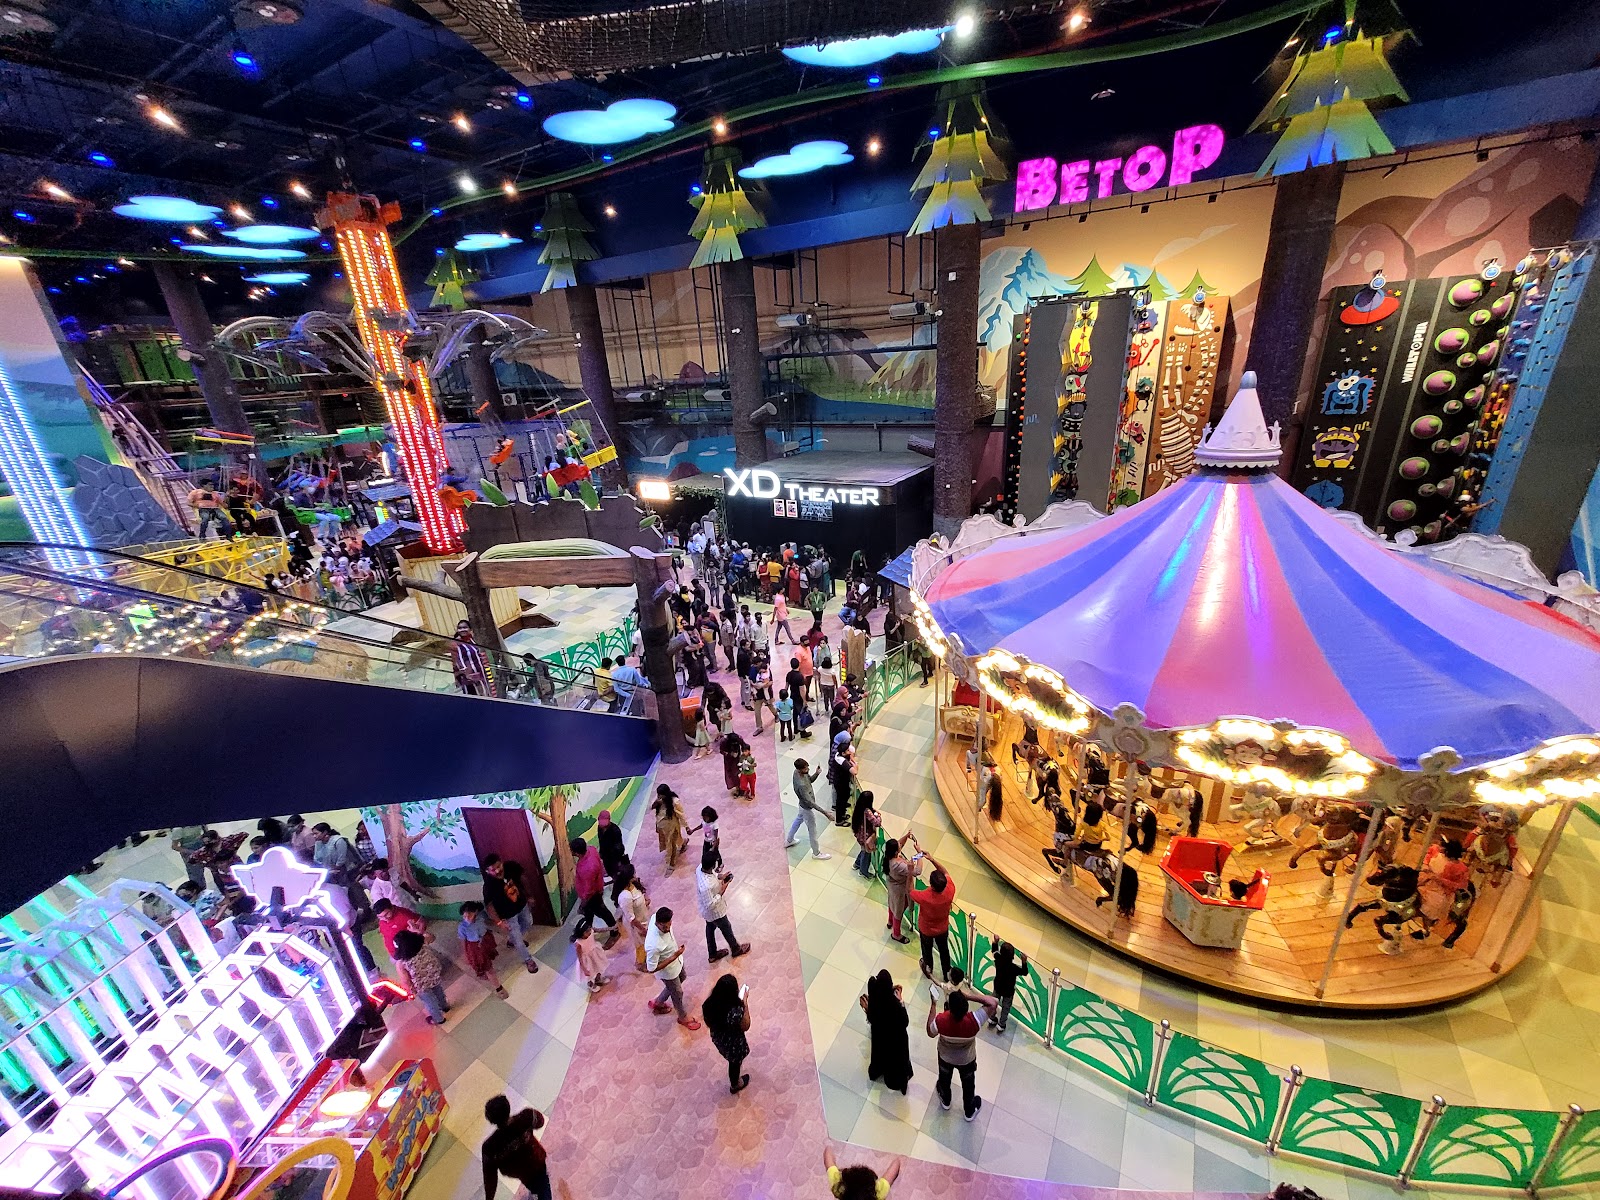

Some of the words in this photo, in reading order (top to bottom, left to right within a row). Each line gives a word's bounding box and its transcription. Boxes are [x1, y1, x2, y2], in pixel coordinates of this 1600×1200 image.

[1015, 124, 1224, 213] BETOP
[724, 468, 781, 499] XD
[784, 483, 880, 506] THEATER
